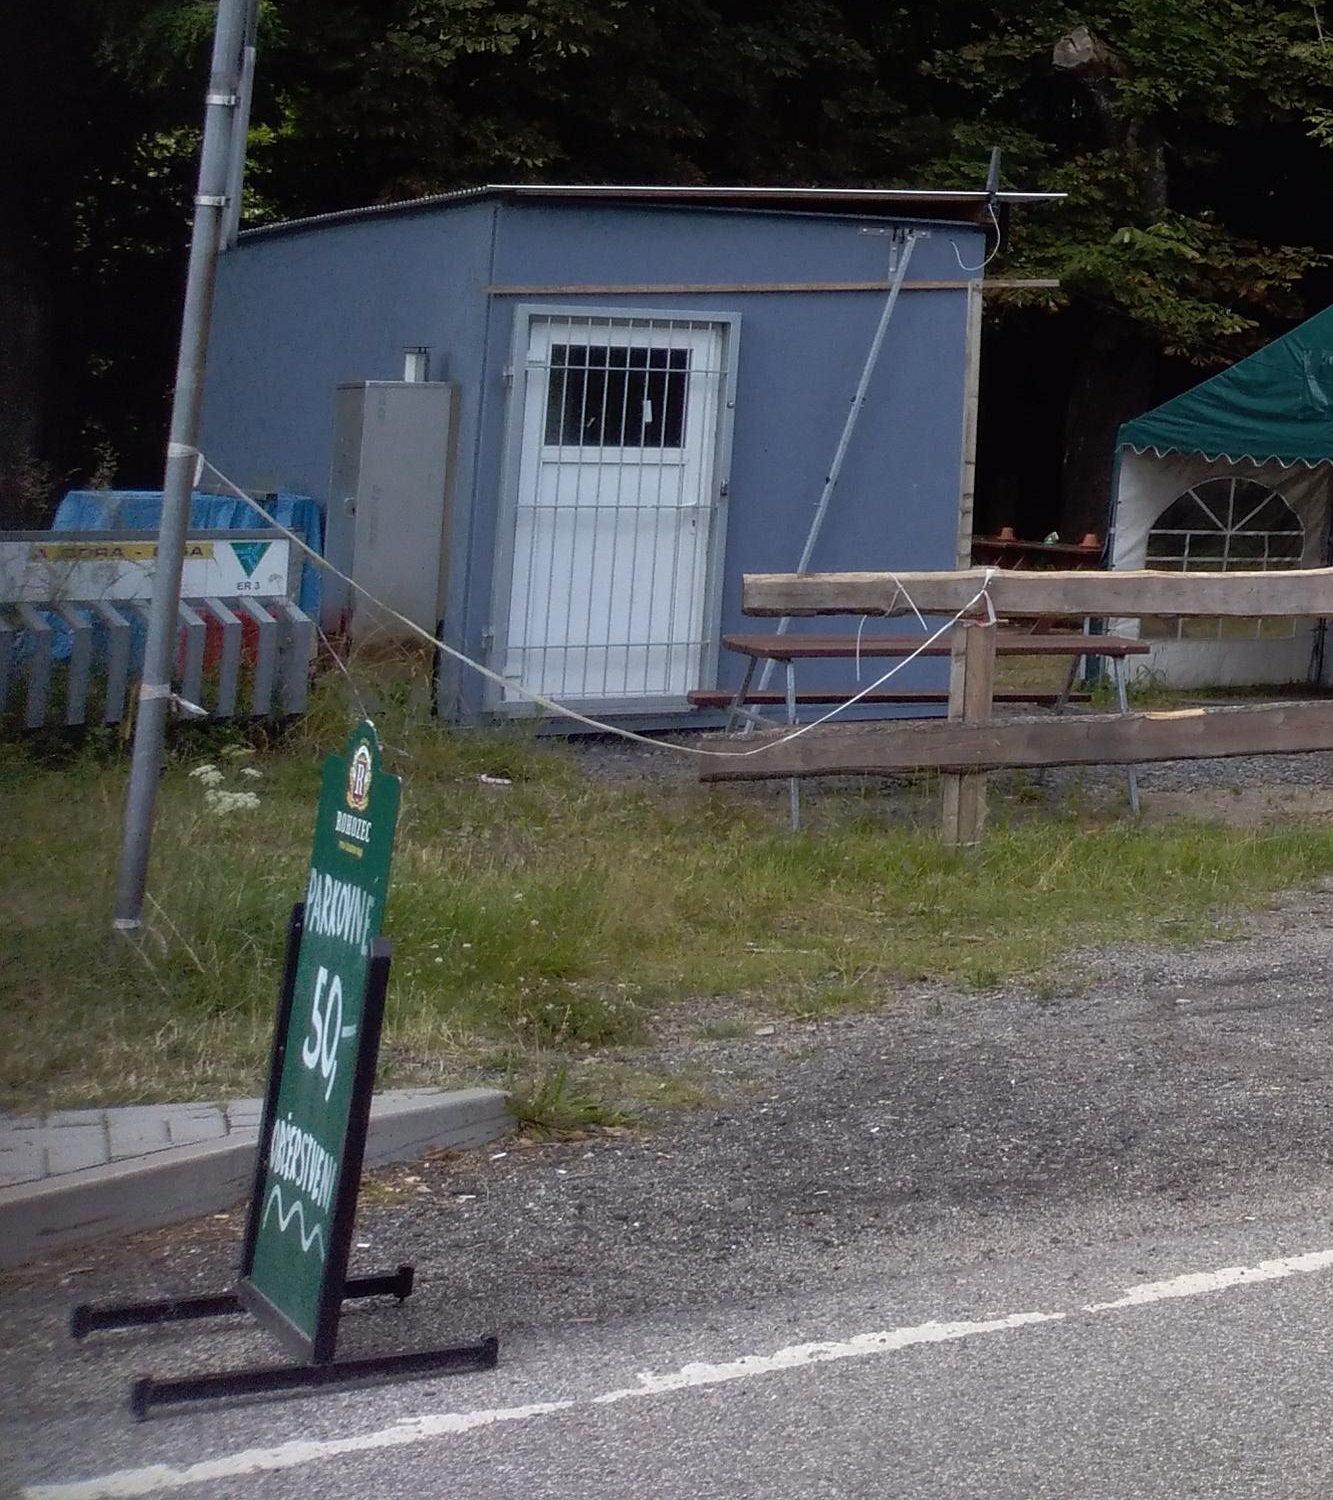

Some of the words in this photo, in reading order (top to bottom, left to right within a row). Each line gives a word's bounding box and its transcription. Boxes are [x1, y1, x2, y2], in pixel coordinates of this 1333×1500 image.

[237, 581, 252, 591] ER
[254, 581, 261, 590] 3
[335, 810, 373, 843] ROHOZEC
